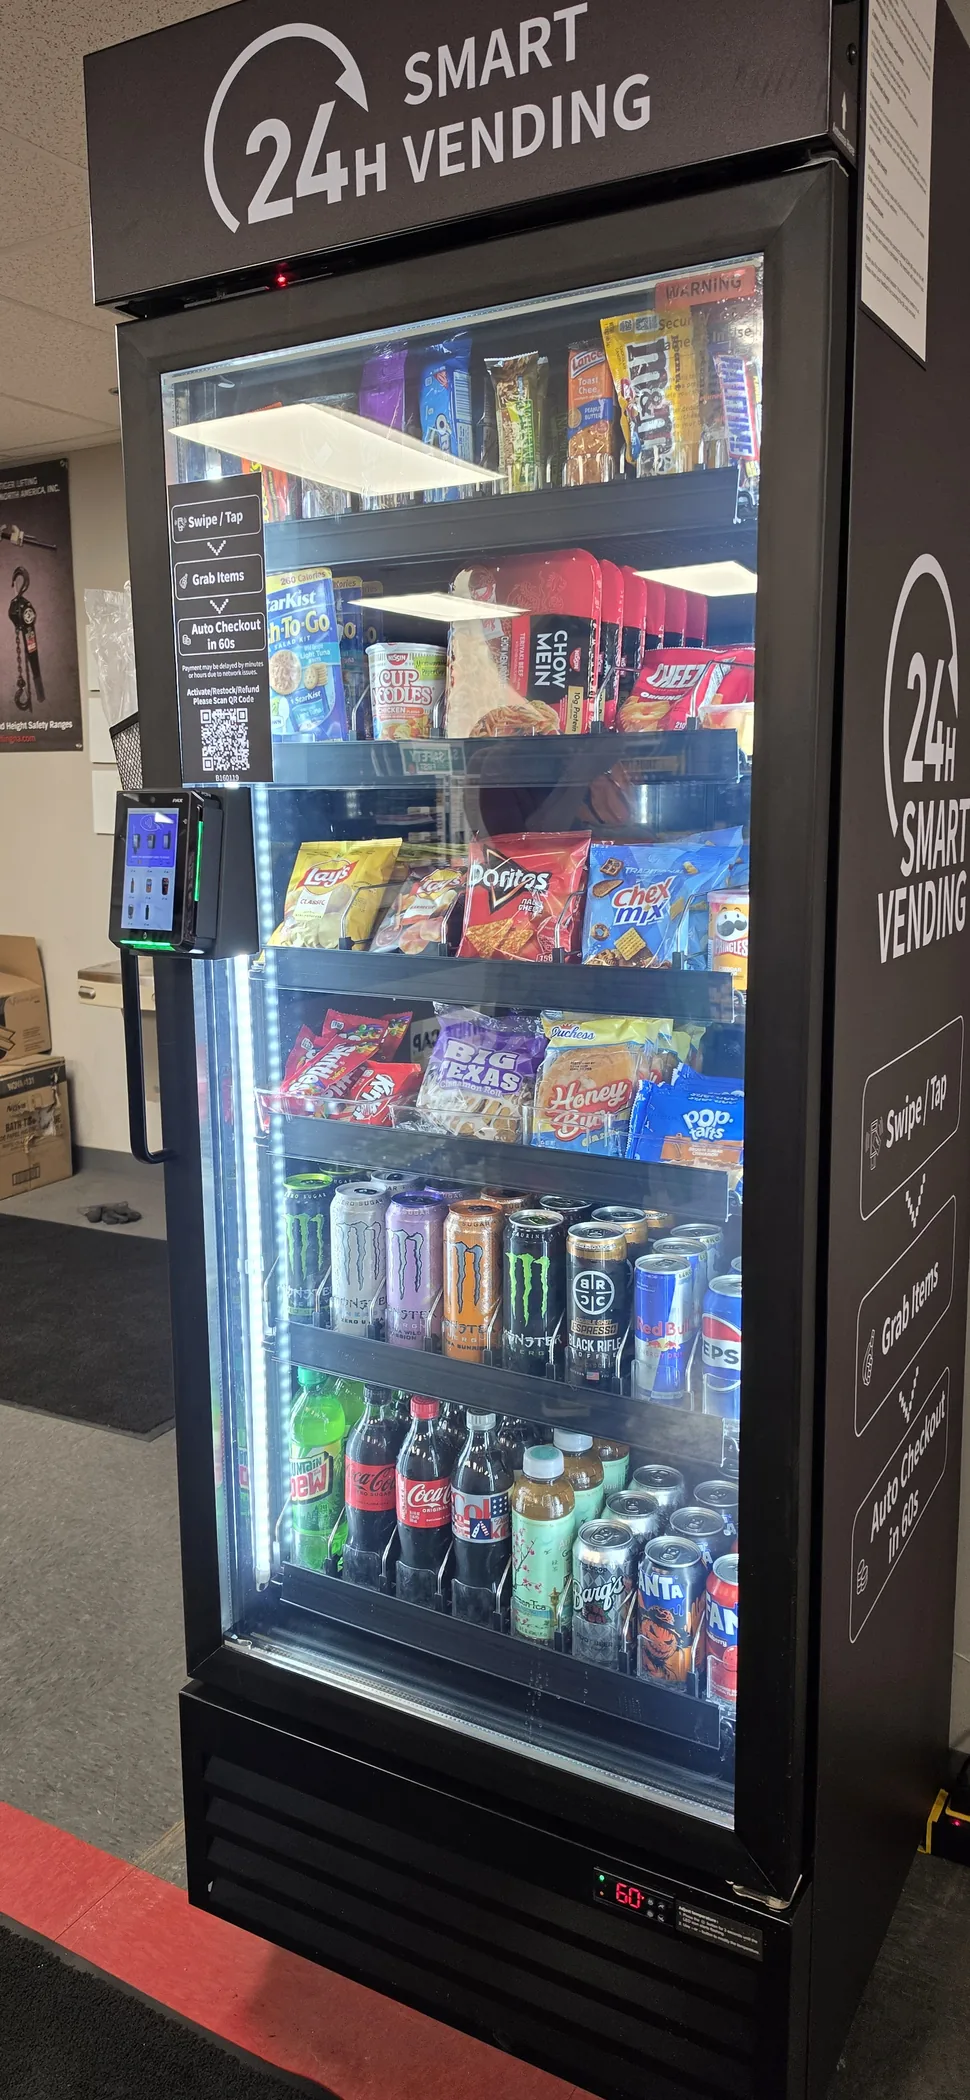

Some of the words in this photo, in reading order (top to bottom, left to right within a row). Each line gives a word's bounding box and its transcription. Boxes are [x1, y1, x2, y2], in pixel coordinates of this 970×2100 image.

[404, 2, 588, 107] SMART
[402, 73, 652, 184] VENDING
[666, 273, 743, 299] WARNING
[578, 376, 599, 387] Toast
[16, 476, 38, 488] LIFTING
[188, 515, 218, 528] Swipe
[219, 511, 224, 526] /
[225, 511, 244, 525] Tap
[192, 572, 215, 586] Grab
[217, 571, 245, 583] Items
[281, 577, 296, 586] 260
[297, 571, 326, 583] Calories
[267, 590, 317, 613] tarKist
[191, 623, 214, 635] Auto
[215, 619, 261, 633] Checkout
[207, 638, 217, 651] in
[220, 638, 236, 650] 60s
[274, 641, 296, 651] SALAD
[299, 635, 311, 644] KIT
[518, 633, 526, 662] TERIYAKI
[182, 664, 202, 672] Payment
[219, 662, 238, 670] delayed
[237, 661, 244, 669] by
[534, 633, 553, 686] MEIN
[552, 629, 568, 689] CHOW
[222, 669, 241, 677] network
[380, 669, 420, 688] CUP
[186, 685, 260, 697] Activate/Restock/Refund
[212, 697, 227, 705] Scan
[228, 696, 238, 705] QR
[238, 695, 254, 703] Code
[372, 686, 433, 706] NOODLES
[571, 692, 581, 705] 10g
[377, 707, 406, 715] CHICKEN
[571, 705, 581, 732] Protein
[903, 651, 957, 783] 24H
[6, 721, 28, 732] Height
[28, 720, 48, 731] Safety
[49, 720, 73, 731] Ranges
[900, 799, 970, 877] SMART
[304, 865, 351, 887] Lay's
[469, 864, 550, 892] Doritos
[625, 866, 684, 876] TRADITIONAL
[613, 876, 674, 907] Chex
[615, 902, 664, 926] mix
[877, 869, 968, 964] VENDING
[715, 939, 748, 958] PRINGLES
[551, 1026, 595, 1041] Duchess
[444, 1039, 520, 1071] BIG
[439, 1080, 483, 1094] Cinnamon
[440, 1061, 523, 1093] TEXAS
[551, 1081, 629, 1111] Honey
[886, 1094, 922, 1149] Swipe
[922, 1078, 929, 1126] /
[930, 1074, 947, 1111] Tap
[5, 1121, 22, 1133] BATH
[689, 1126, 725, 1142] tarts
[303, 1192, 327, 1200] SUGAR
[358, 1199, 384, 1207] SUGAR
[881, 1294, 910, 1356] Grab
[911, 1261, 939, 1319] Items
[571, 1323, 617, 1335] ESPRESSO
[636, 1316, 663, 1336] Red
[665, 1321, 691, 1336] Bull
[568, 1333, 595, 1353] BLACK
[597, 1337, 622, 1353] RIFLE
[704, 1341, 739, 1365] EPS
[870, 1476, 899, 1544] Auto
[900, 1390, 946, 1488] Checkout
[888, 1526, 899, 1564] in
[901, 1489, 919, 1538] 60s
[572, 1575, 624, 1611] Barq's
[638, 1570, 684, 1601] ANTA
[615, 1882, 642, 1910] 60
